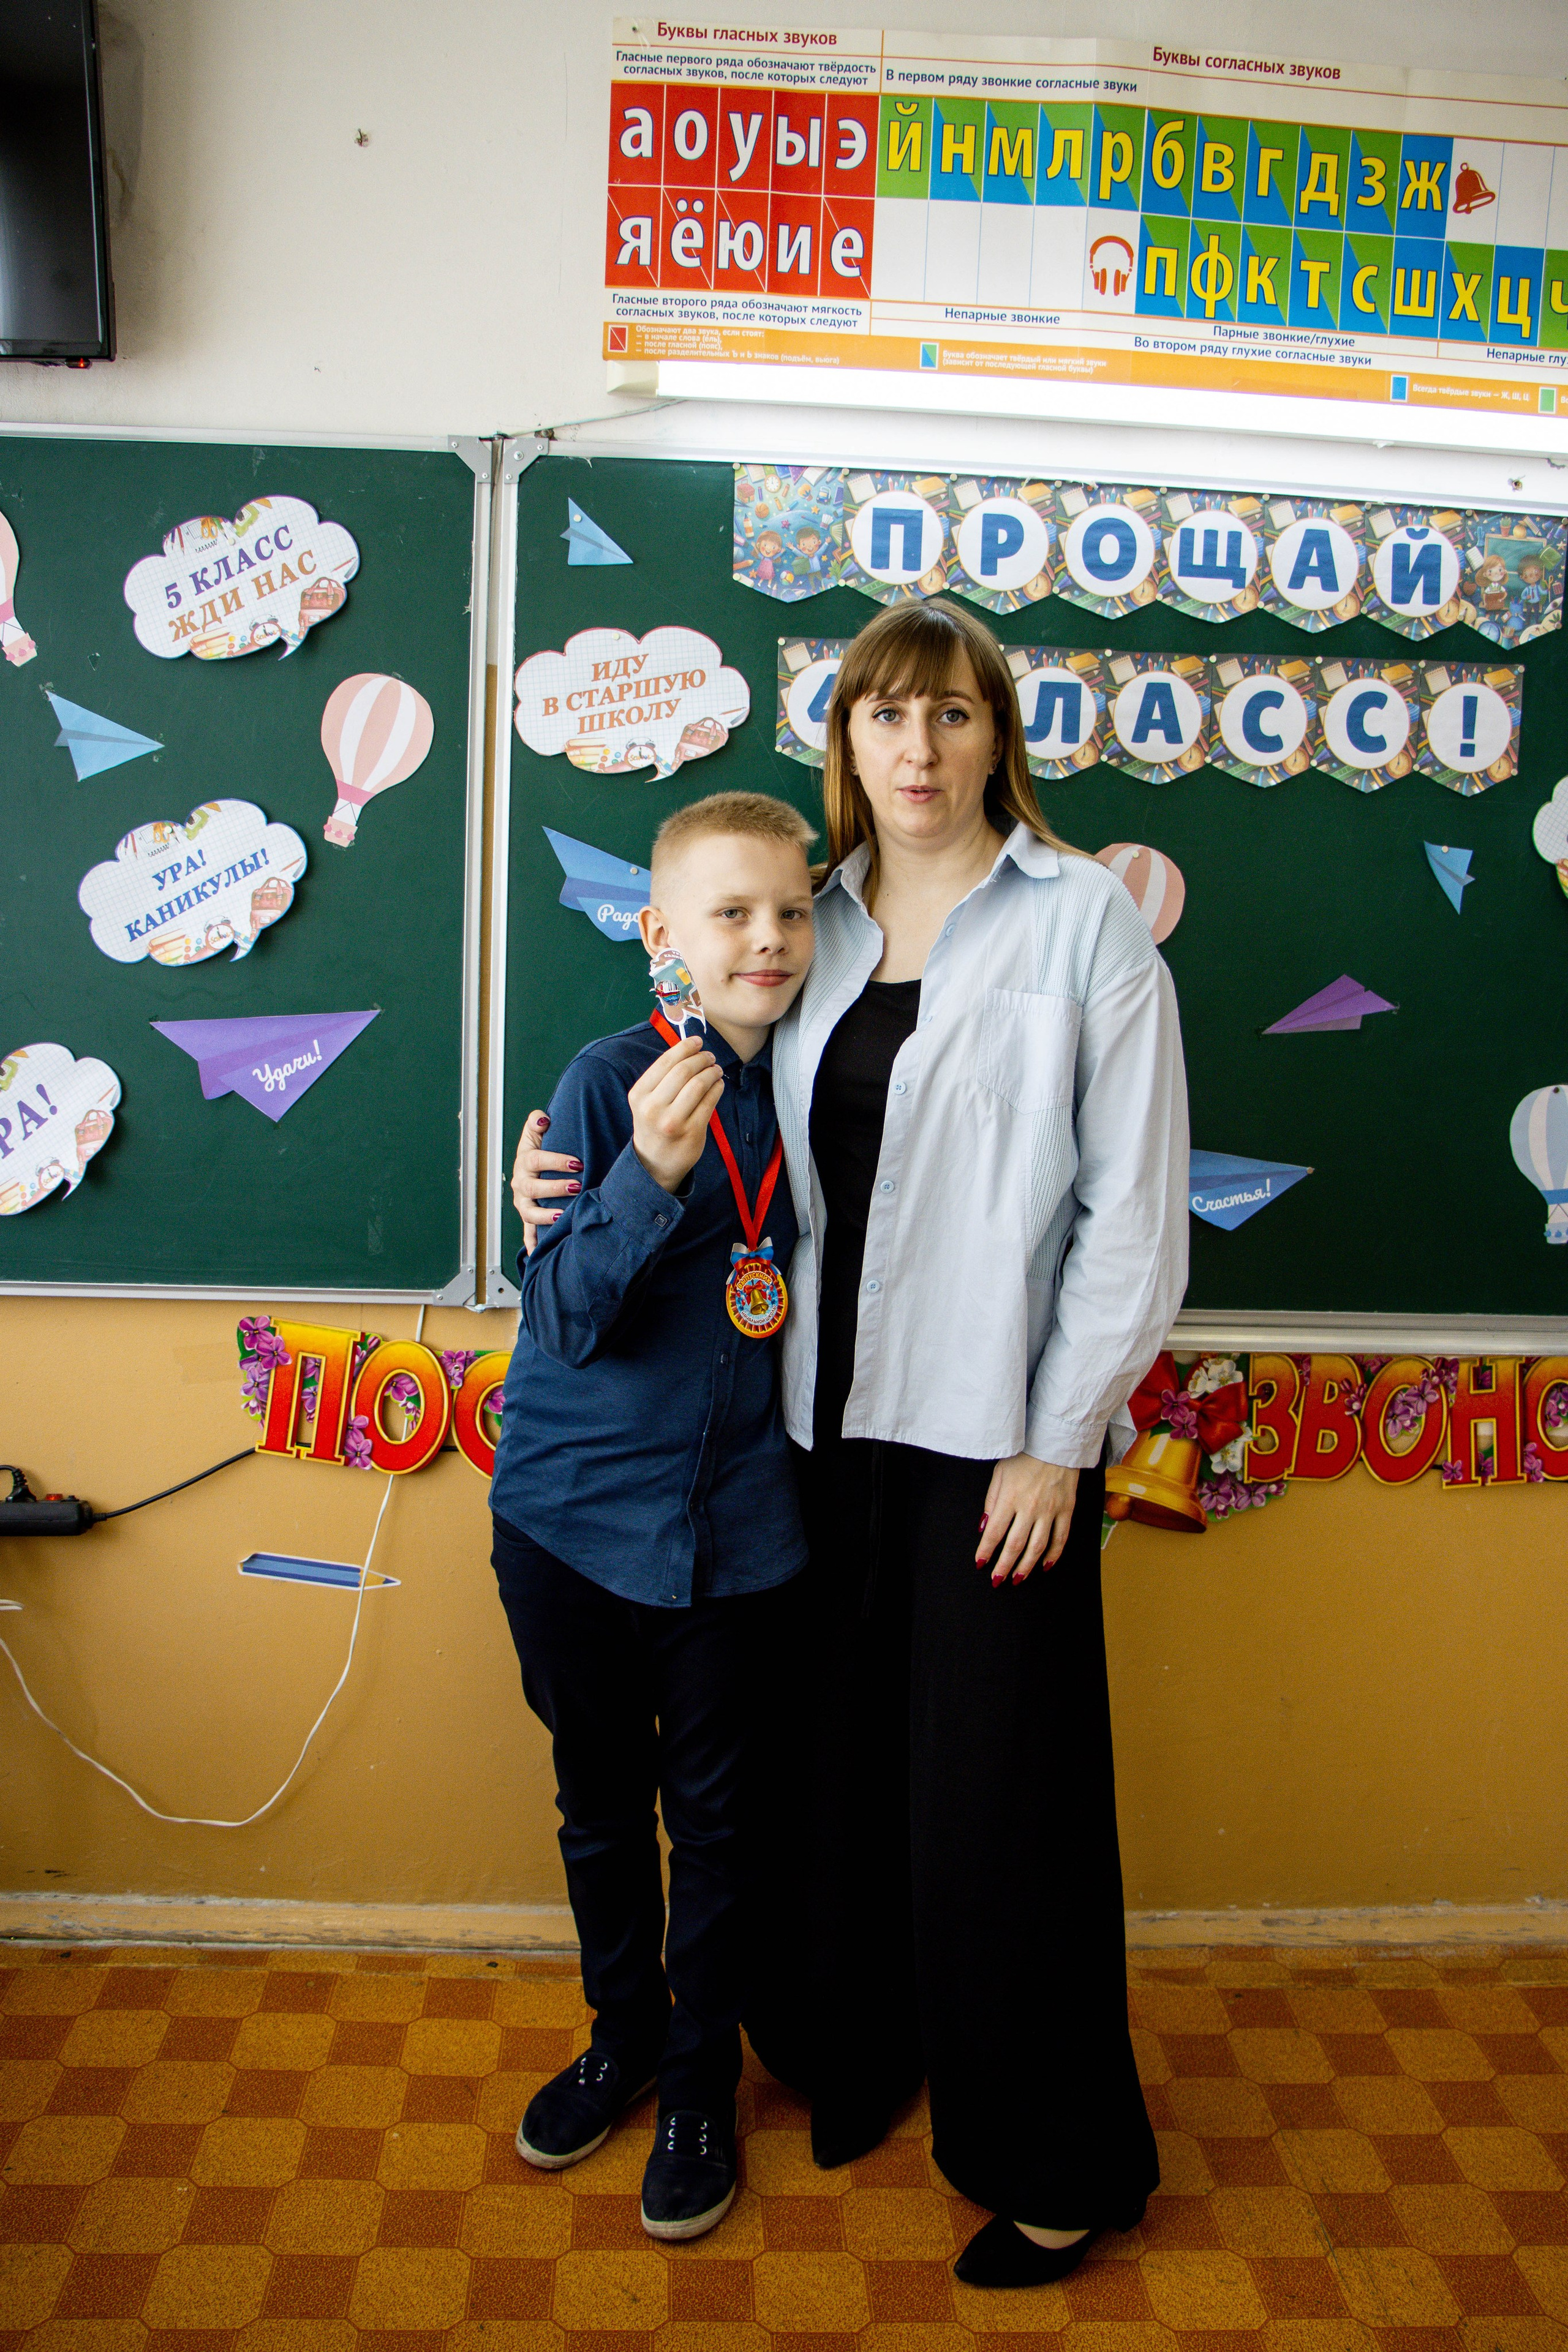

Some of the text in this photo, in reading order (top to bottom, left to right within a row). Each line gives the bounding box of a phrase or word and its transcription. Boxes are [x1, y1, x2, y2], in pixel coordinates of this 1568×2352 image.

[657, 21, 837, 48] Буквы гласных звуков
[616, 50, 876, 75] Гласные первого ряда обозначают твёрдость
[1153, 46, 1341, 81] Буквы согласных звуков
[624, 66, 869, 87] согласных звуков, после которых следуют
[886, 69, 1137, 94] В первом ряду звонкие согласные звуки
[612, 293, 862, 316] Гласные второго ряда обозначают мягкость
[944, 307, 1060, 325] Непарные звонкие
[616, 307, 858, 329] согласных звуков, после которых следуют
[636, 325, 681, 334] Обозначают
[1213, 325, 1355, 348] Парные звонкие/глухие
[668, 349, 729, 358] разделительных
[943, 350, 965, 360] Буква
[966, 352, 1008, 361] обозначает
[1009, 355, 1041, 364] твёрдый
[1134, 336, 1371, 366] Во втором ряду глухие согласные звуки
[1487, 348, 1568, 367] Непарные глу
[943, 358, 973, 366] (зависит
[985, 361, 1036, 371] последующей
[1413, 384, 1436, 393] Всегда
[1439, 386, 1469, 396] твёрдые
[1471, 390, 1491, 399] звуки
[165, 524, 293, 609] 5 КЛАСС
[870, 507, 1442, 606] ПРОЩАЙ
[168, 549, 317, 643] ЖДИ НАС
[591, 653, 649, 682] ИДУ
[542, 669, 706, 717] В СТАРШУЮ
[577, 698, 682, 735] ШКОЛУ
[1024, 680, 1477, 758] ЛАСС!
[152, 849, 206, 891] УРА!
[124, 848, 270, 942] КАНИКУЛЫ!
[597, 904, 639, 930] Радо
[252, 1039, 322, 1093] Удачи!
[0, 1084, 58, 1159] РА!
[1192, 1178, 1271, 1212] Счастья!
[737, 1272, 772, 1290] ВЫПУСКНИК
[741, 1305, 777, 1324] НАЧАЛЬНОЙ ШКОЛЫ
